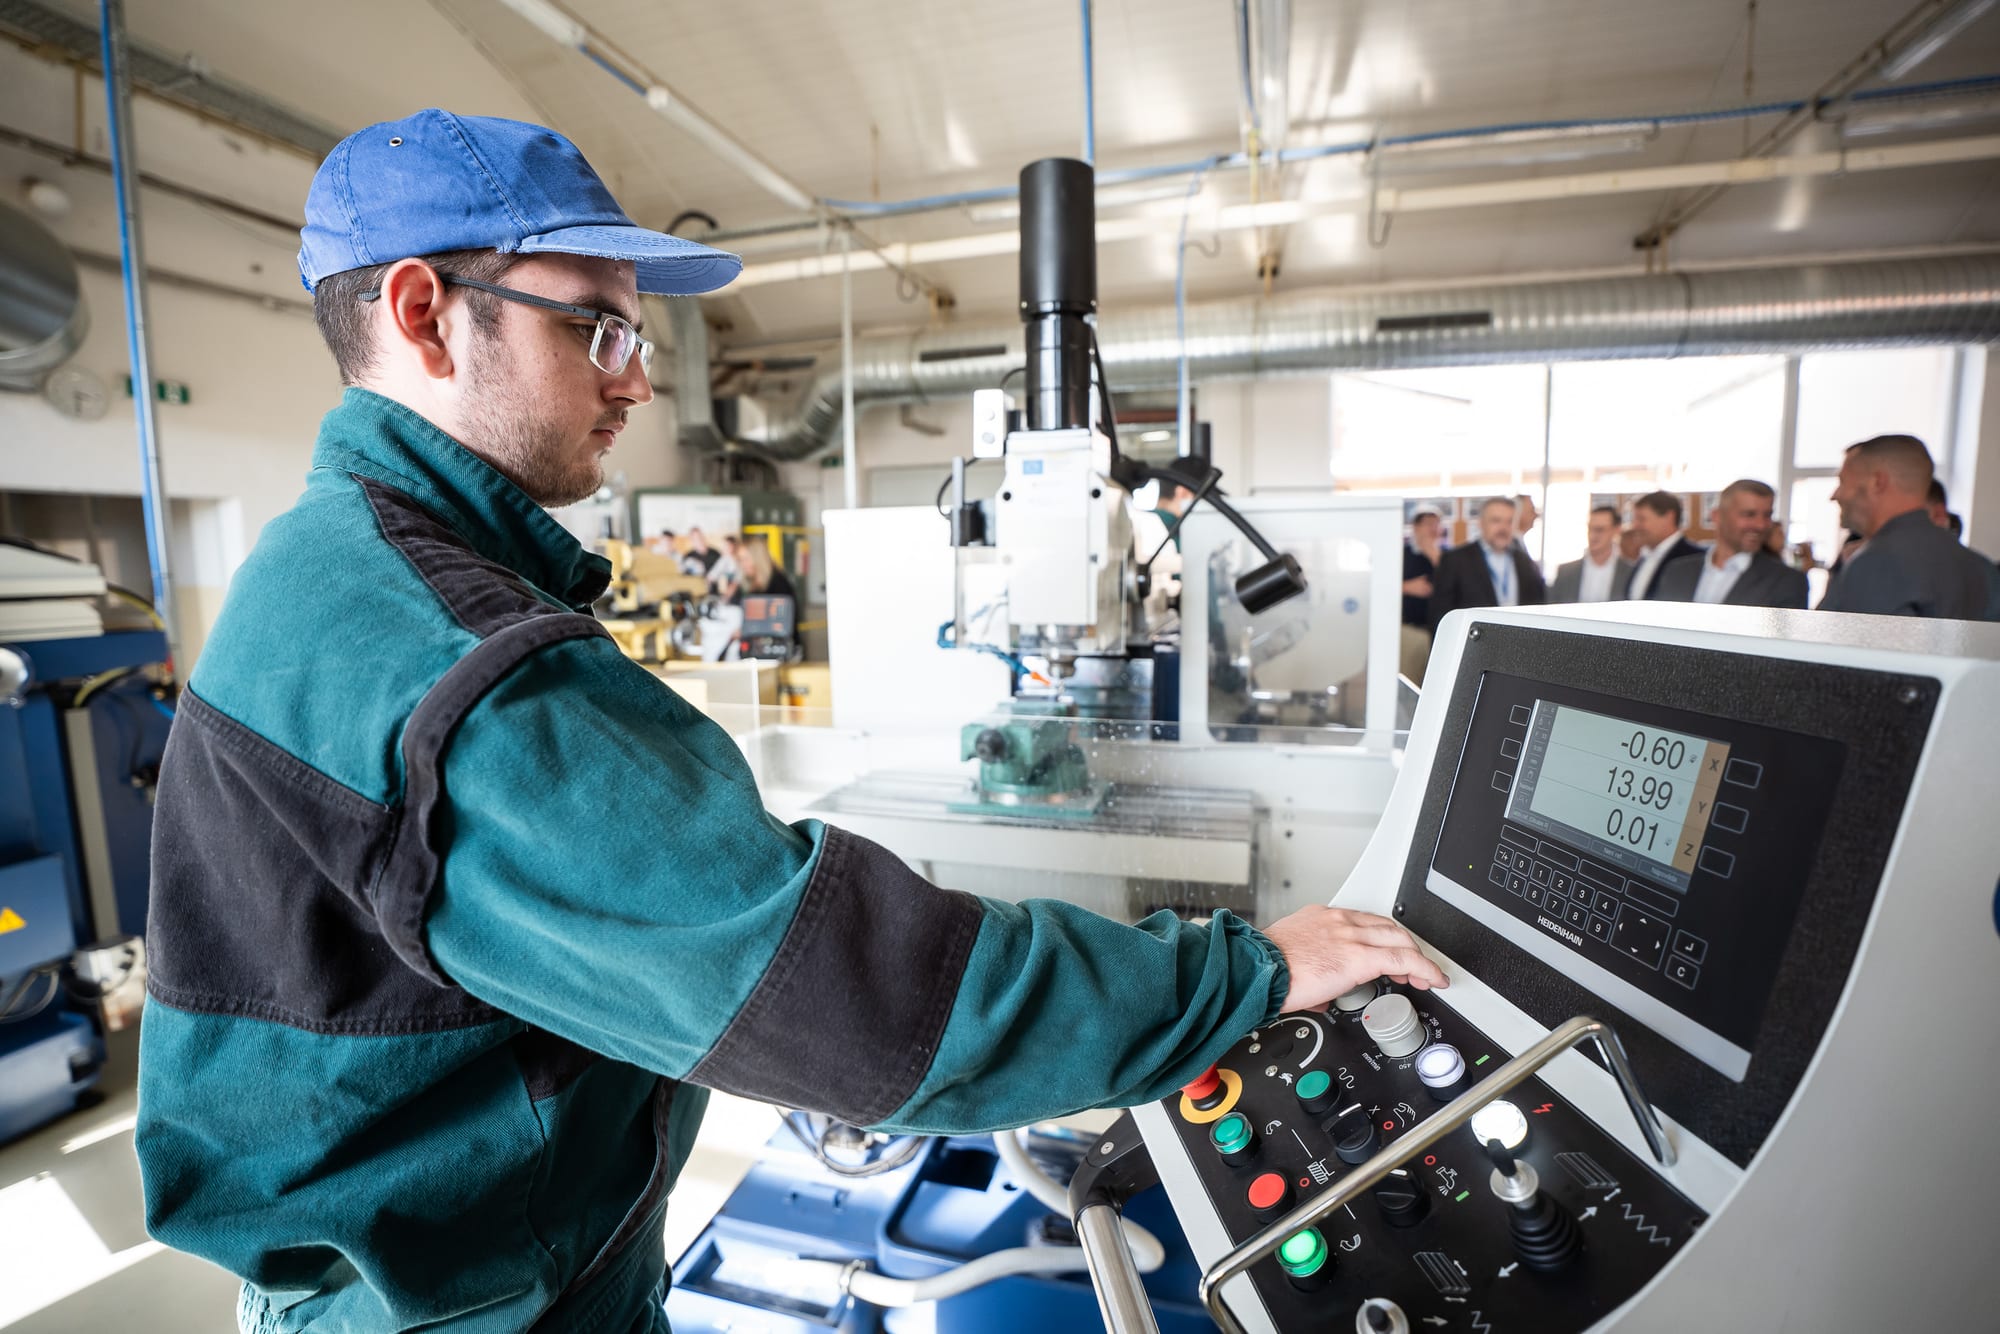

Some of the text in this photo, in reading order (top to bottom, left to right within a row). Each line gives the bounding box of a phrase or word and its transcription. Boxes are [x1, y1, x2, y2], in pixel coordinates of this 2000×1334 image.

[1621, 731, 1685, 770] -0.60
[1709, 758, 1720, 772] X
[1608, 766, 1673, 811] 13.99
[1698, 801, 1707, 814] Y
[1607, 808, 1659, 851] 0.01
[1684, 842, 1695, 857] Z
[1519, 860, 1524, 868] 0
[1557, 879, 1564, 888] 2
[1579, 890, 1585, 899] 3
[1602, 901, 1608, 910] 4
[1513, 880, 1601, 933] 5 6 7 8 9
[1537, 915, 1583, 947] HEIDENHAIN
[1677, 966, 1686, 977] C
[1362, 1052, 1381, 1072] mm/min
